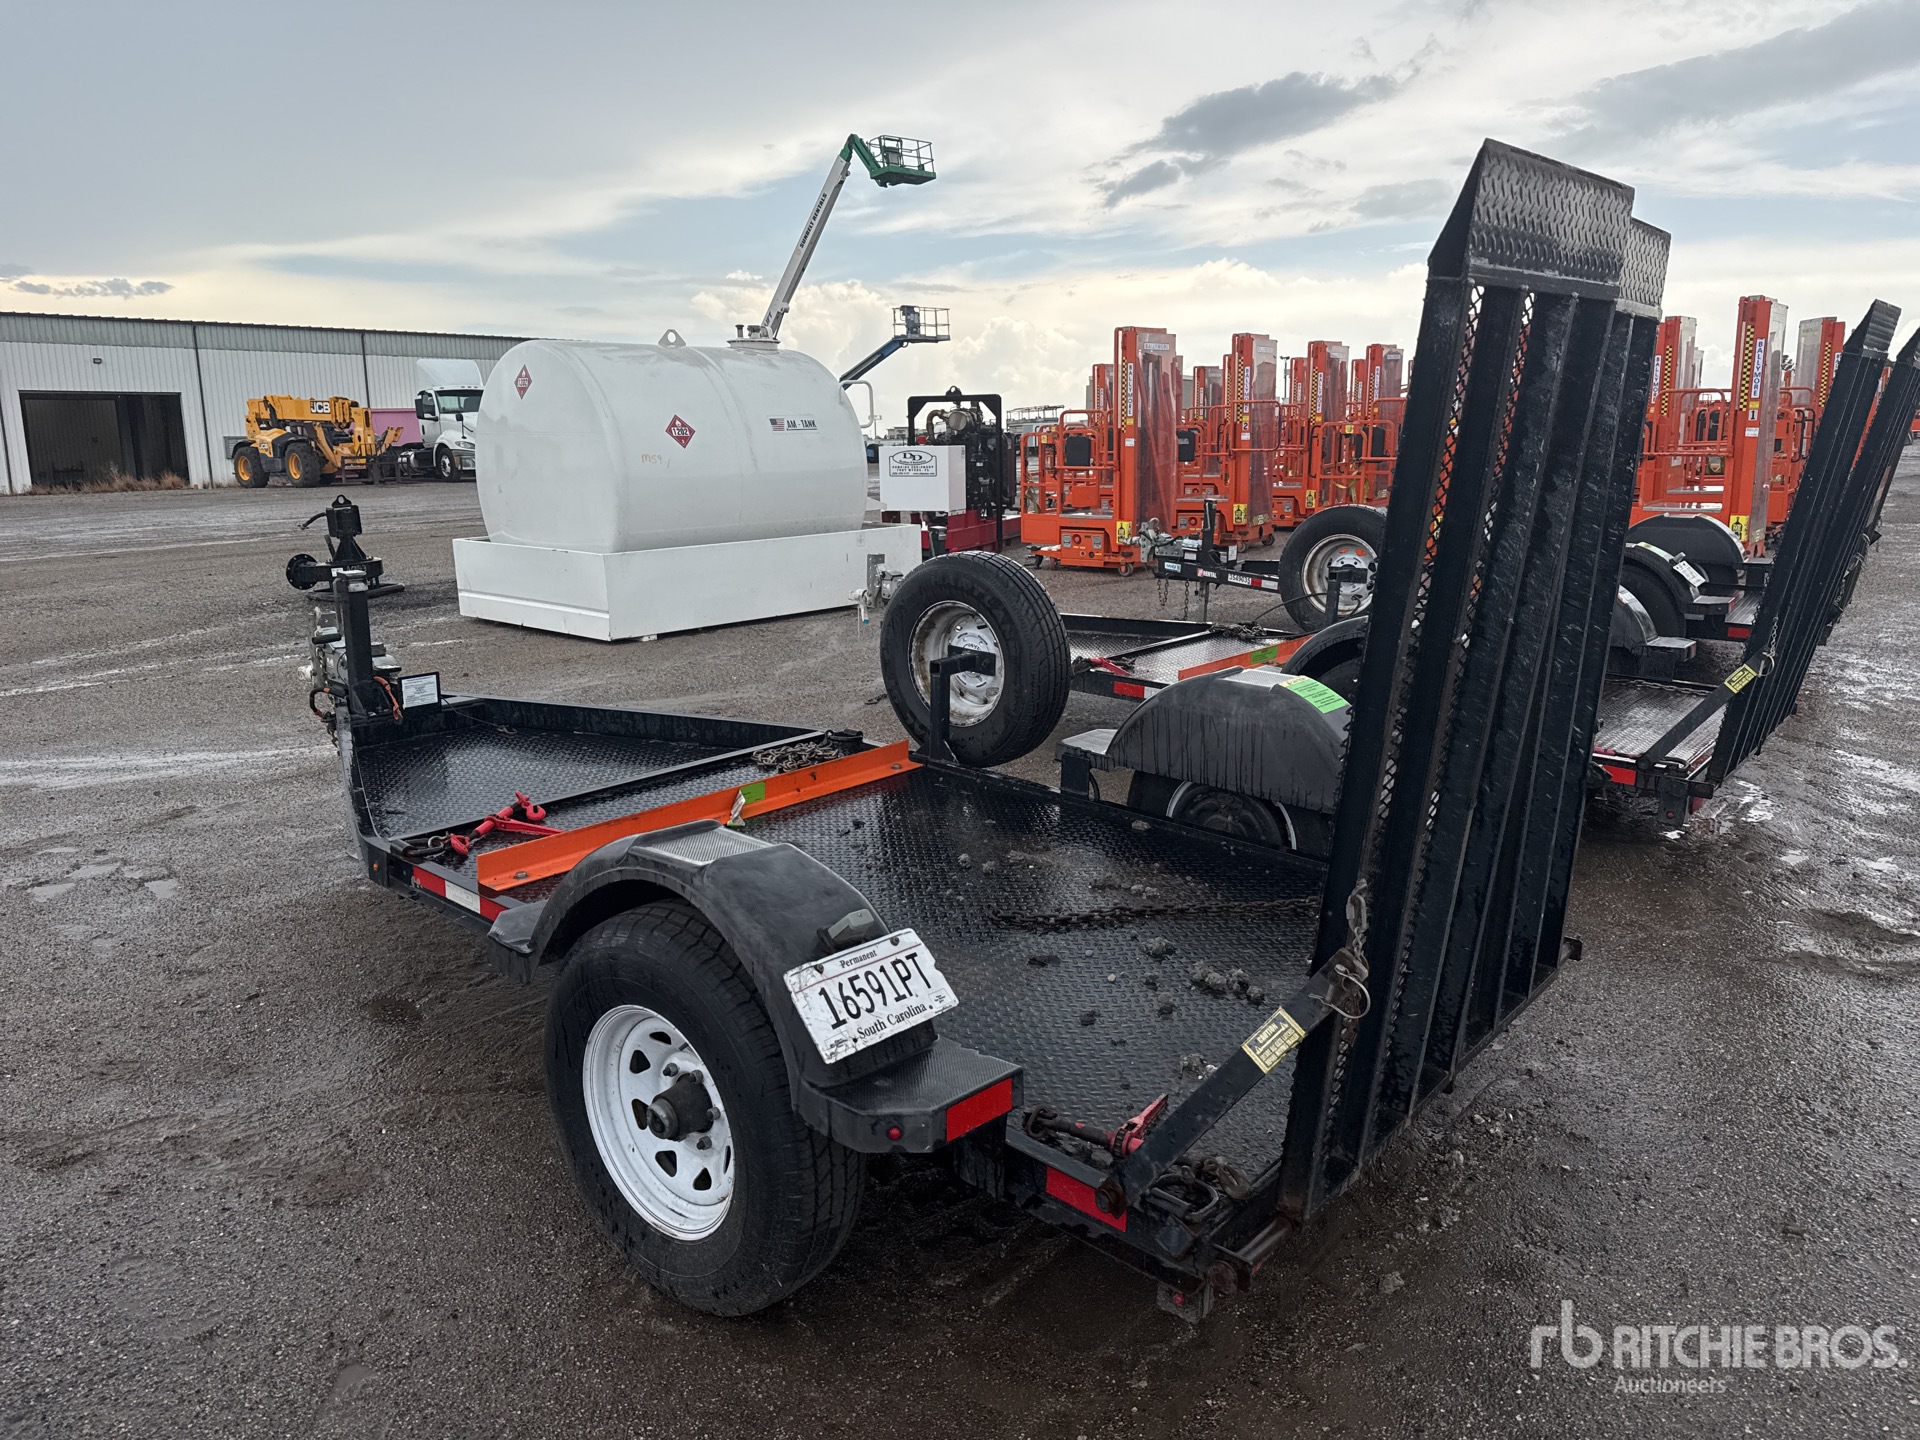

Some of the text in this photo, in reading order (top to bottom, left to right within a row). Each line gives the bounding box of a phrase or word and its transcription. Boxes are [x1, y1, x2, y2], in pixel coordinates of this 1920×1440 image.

[800, 192, 828, 249] SUNBELT RENTALS
[1753, 340, 1764, 397] BALLYMORE
[310, 401, 331, 413] JCB
[673, 427, 688, 436] 1202
[1243, 422, 1248, 430] 2
[1203, 570, 1217, 579] RENTAL
[839, 949, 878, 968] Permanent
[818, 952, 932, 1030] 16591PT
[857, 1002, 927, 1040] South Carolina
[1256, 1022, 1279, 1044] CAUTION
